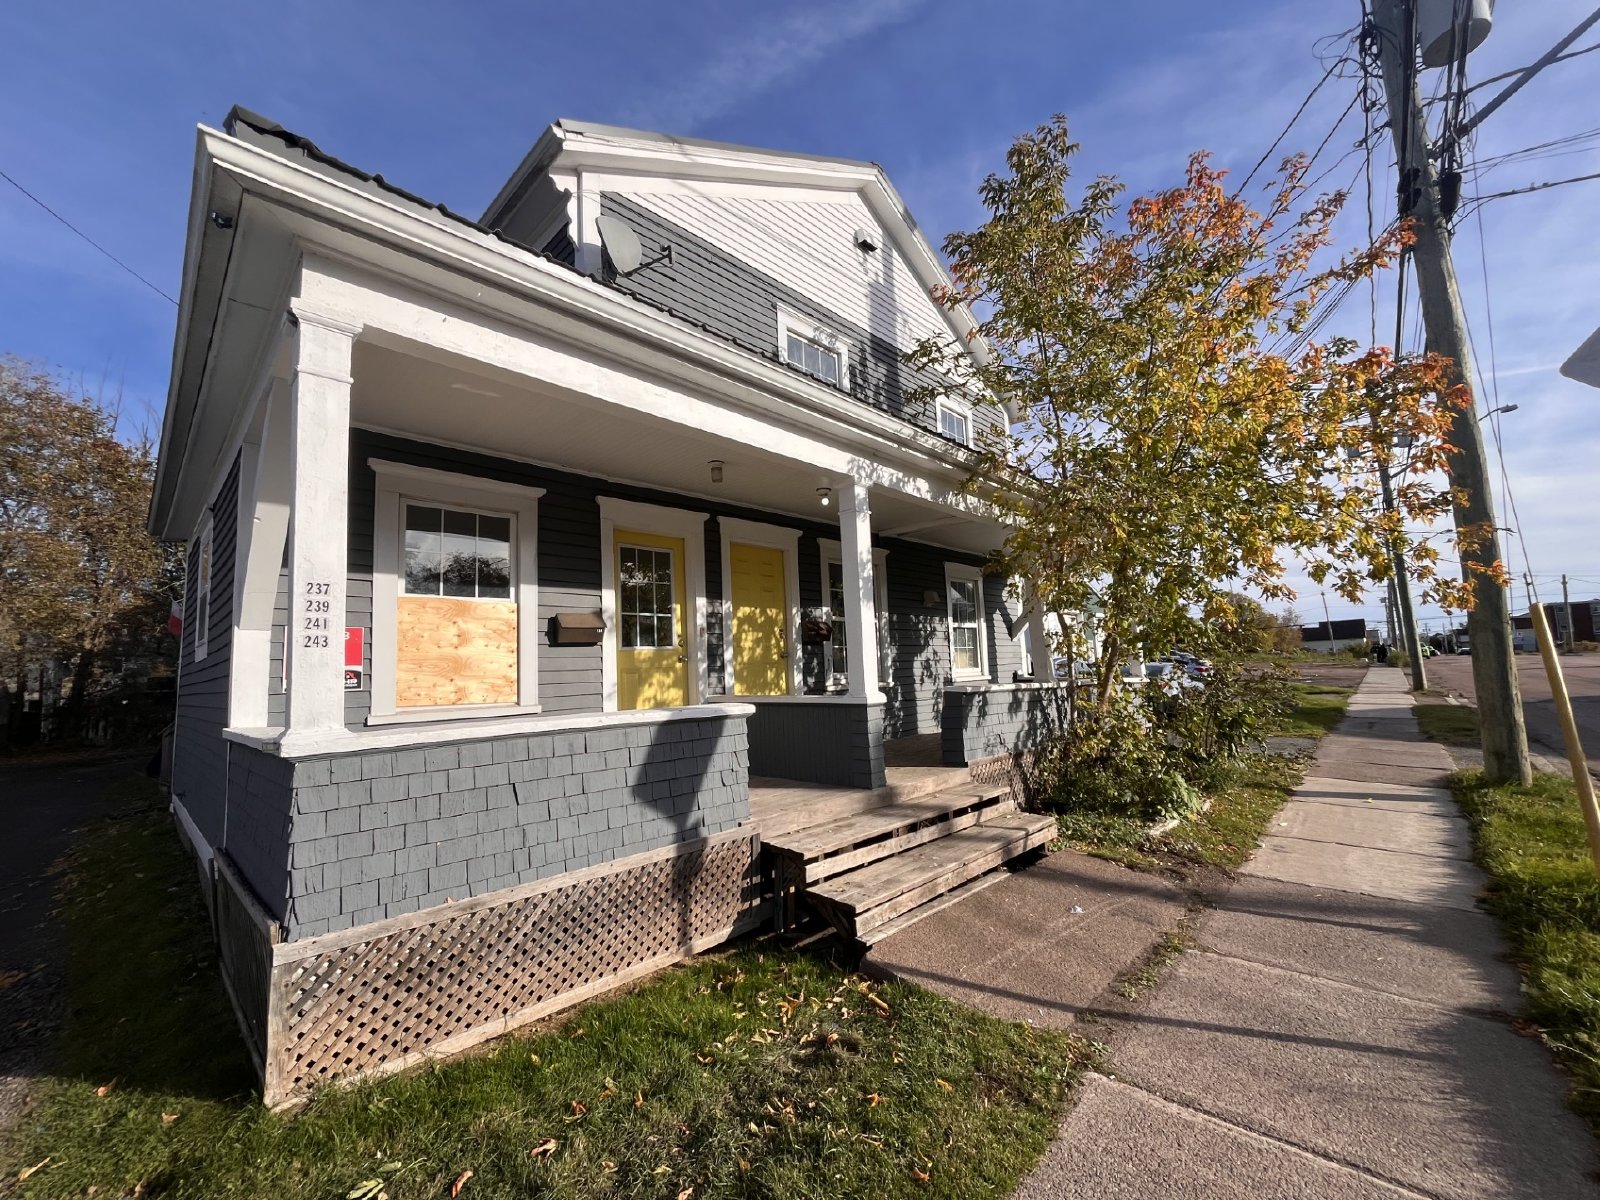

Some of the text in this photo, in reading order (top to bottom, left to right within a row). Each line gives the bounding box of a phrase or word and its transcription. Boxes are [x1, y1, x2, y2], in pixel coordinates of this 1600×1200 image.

[306, 582, 330, 595] 237
[305, 600, 330, 613] 239
[304, 617, 328, 630] 241
[304, 635, 329, 648] 243
